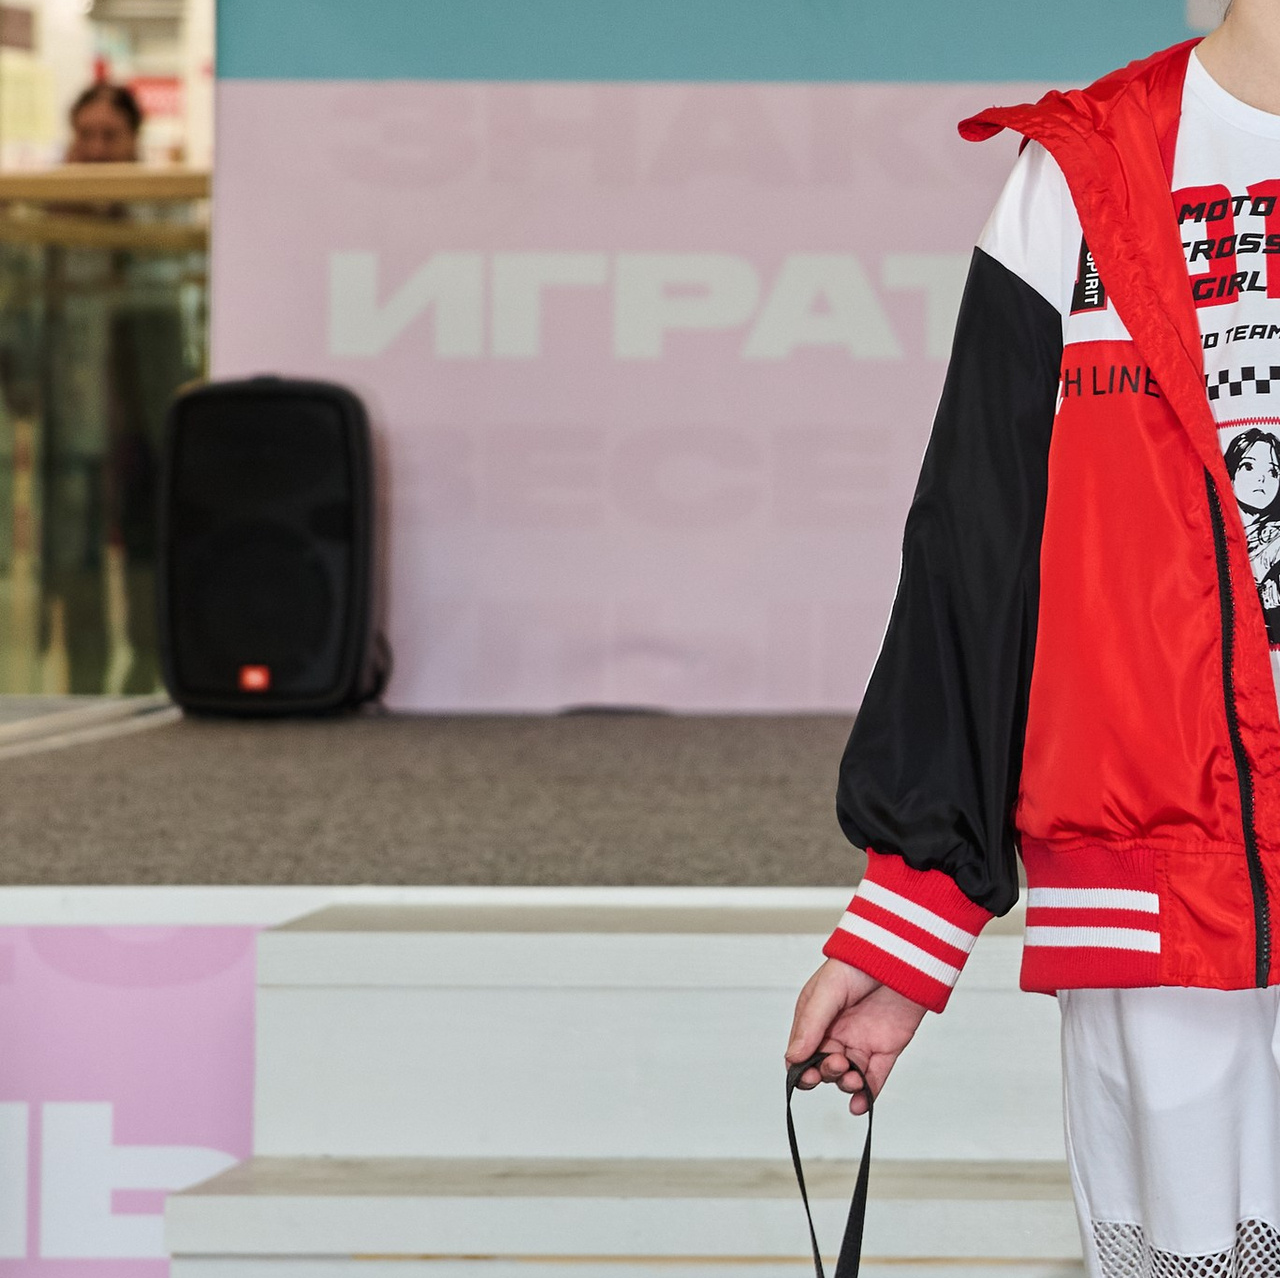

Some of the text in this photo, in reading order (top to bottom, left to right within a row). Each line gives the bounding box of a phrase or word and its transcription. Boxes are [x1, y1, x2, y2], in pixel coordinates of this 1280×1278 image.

[1177, 195, 1277, 225] MOTO
[1192, 270, 1268, 301] GIRL
[1093, 365, 1160, 399] LINE
